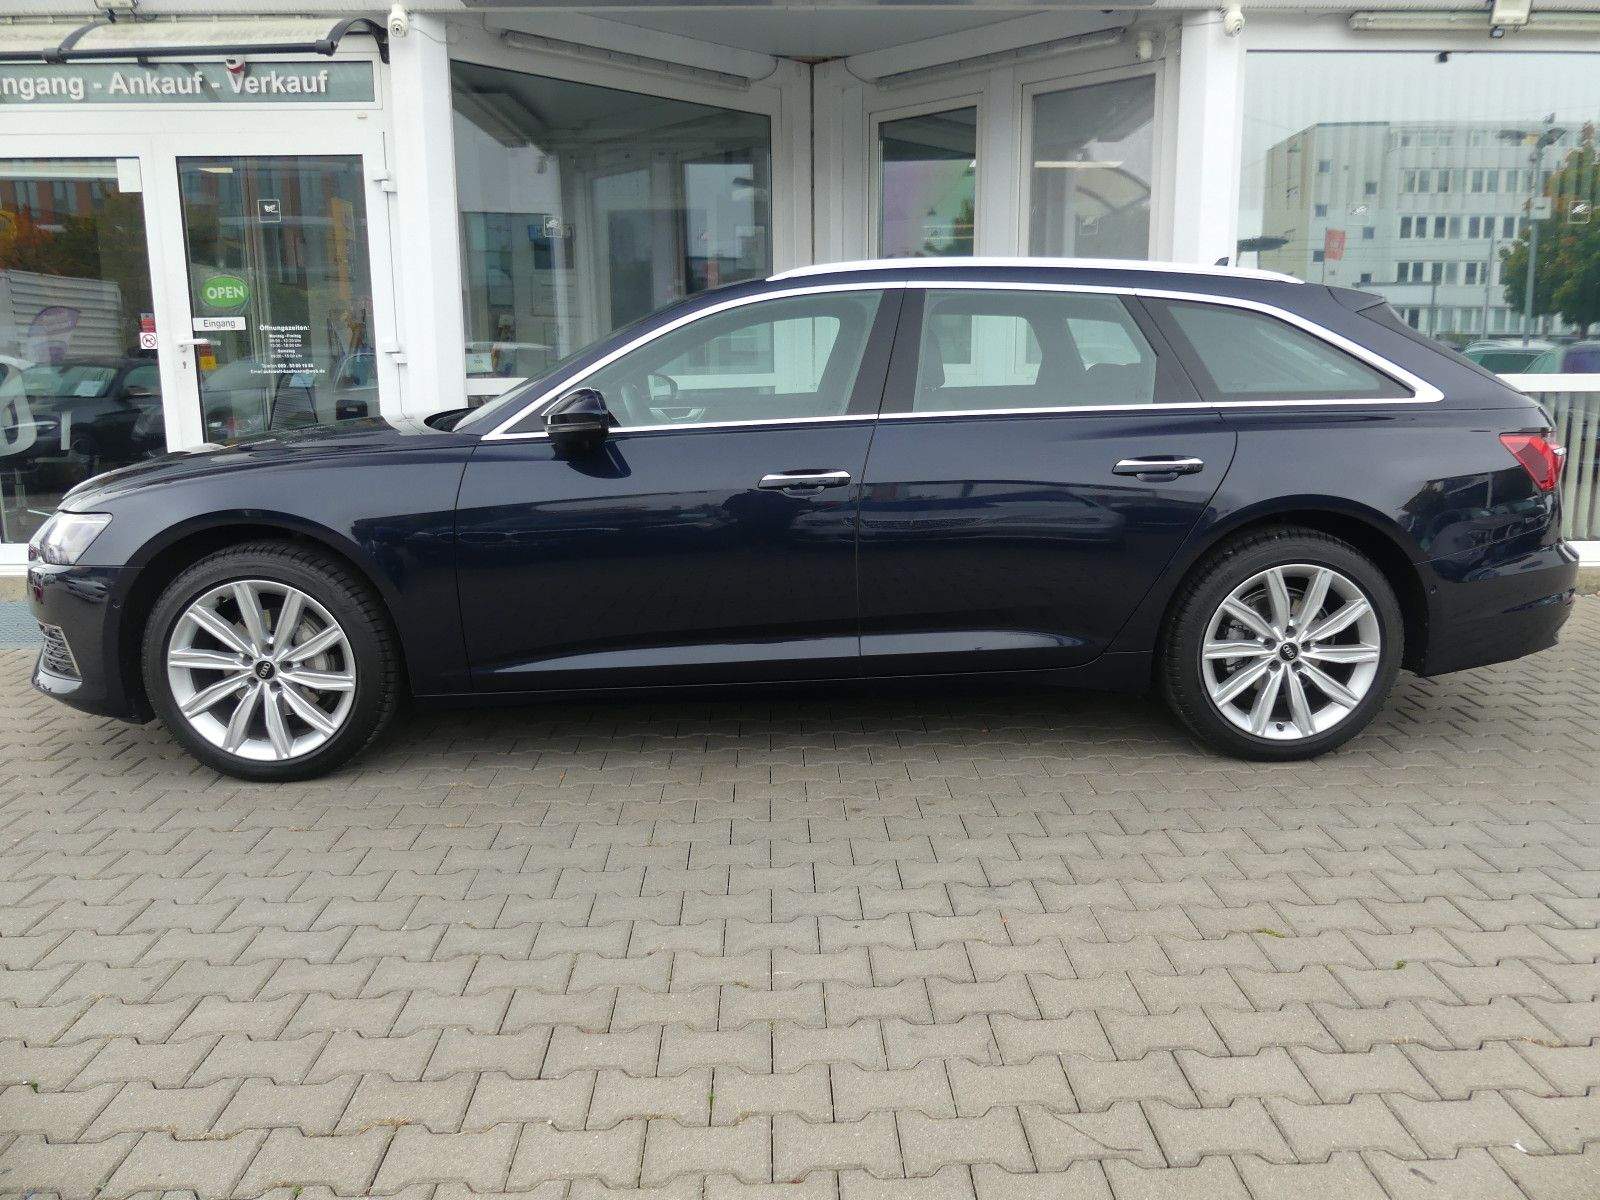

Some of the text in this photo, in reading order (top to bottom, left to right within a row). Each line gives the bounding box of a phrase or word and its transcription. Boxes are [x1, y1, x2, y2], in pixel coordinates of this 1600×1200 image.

[0, 75, 84, 101] ngang
[108, 71, 203, 96] Ankauf
[226, 69, 329, 94] Verkauf
[206, 286, 245, 300] OPEN
[203, 318, 236, 329] Eingang
[259, 323, 311, 332] Öffnungszeiten:
